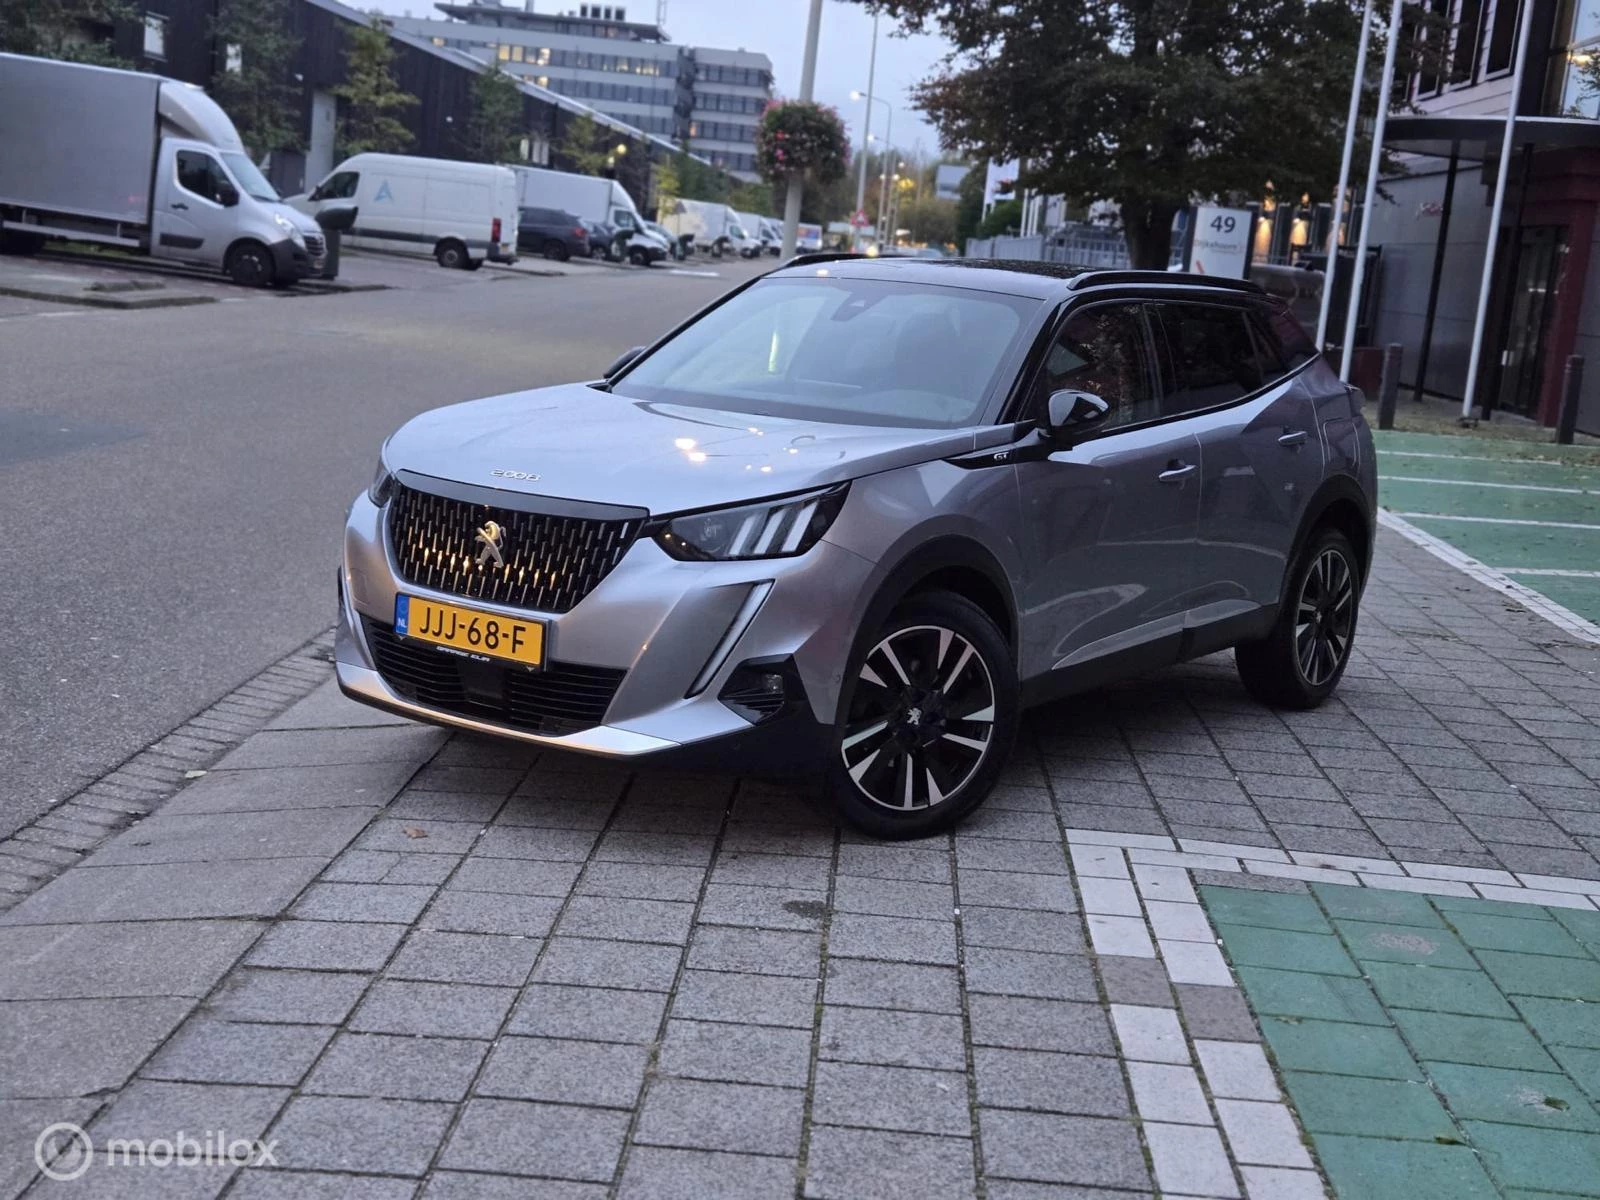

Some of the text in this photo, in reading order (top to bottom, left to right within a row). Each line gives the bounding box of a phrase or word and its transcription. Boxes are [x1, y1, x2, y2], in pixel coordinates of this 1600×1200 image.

[1210, 215, 1236, 233] 49
[993, 451, 1009, 460] GT
[490, 469, 541, 481] 2008
[397, 618, 407, 629] NL
[419, 607, 526, 654] JJJ-68-F
